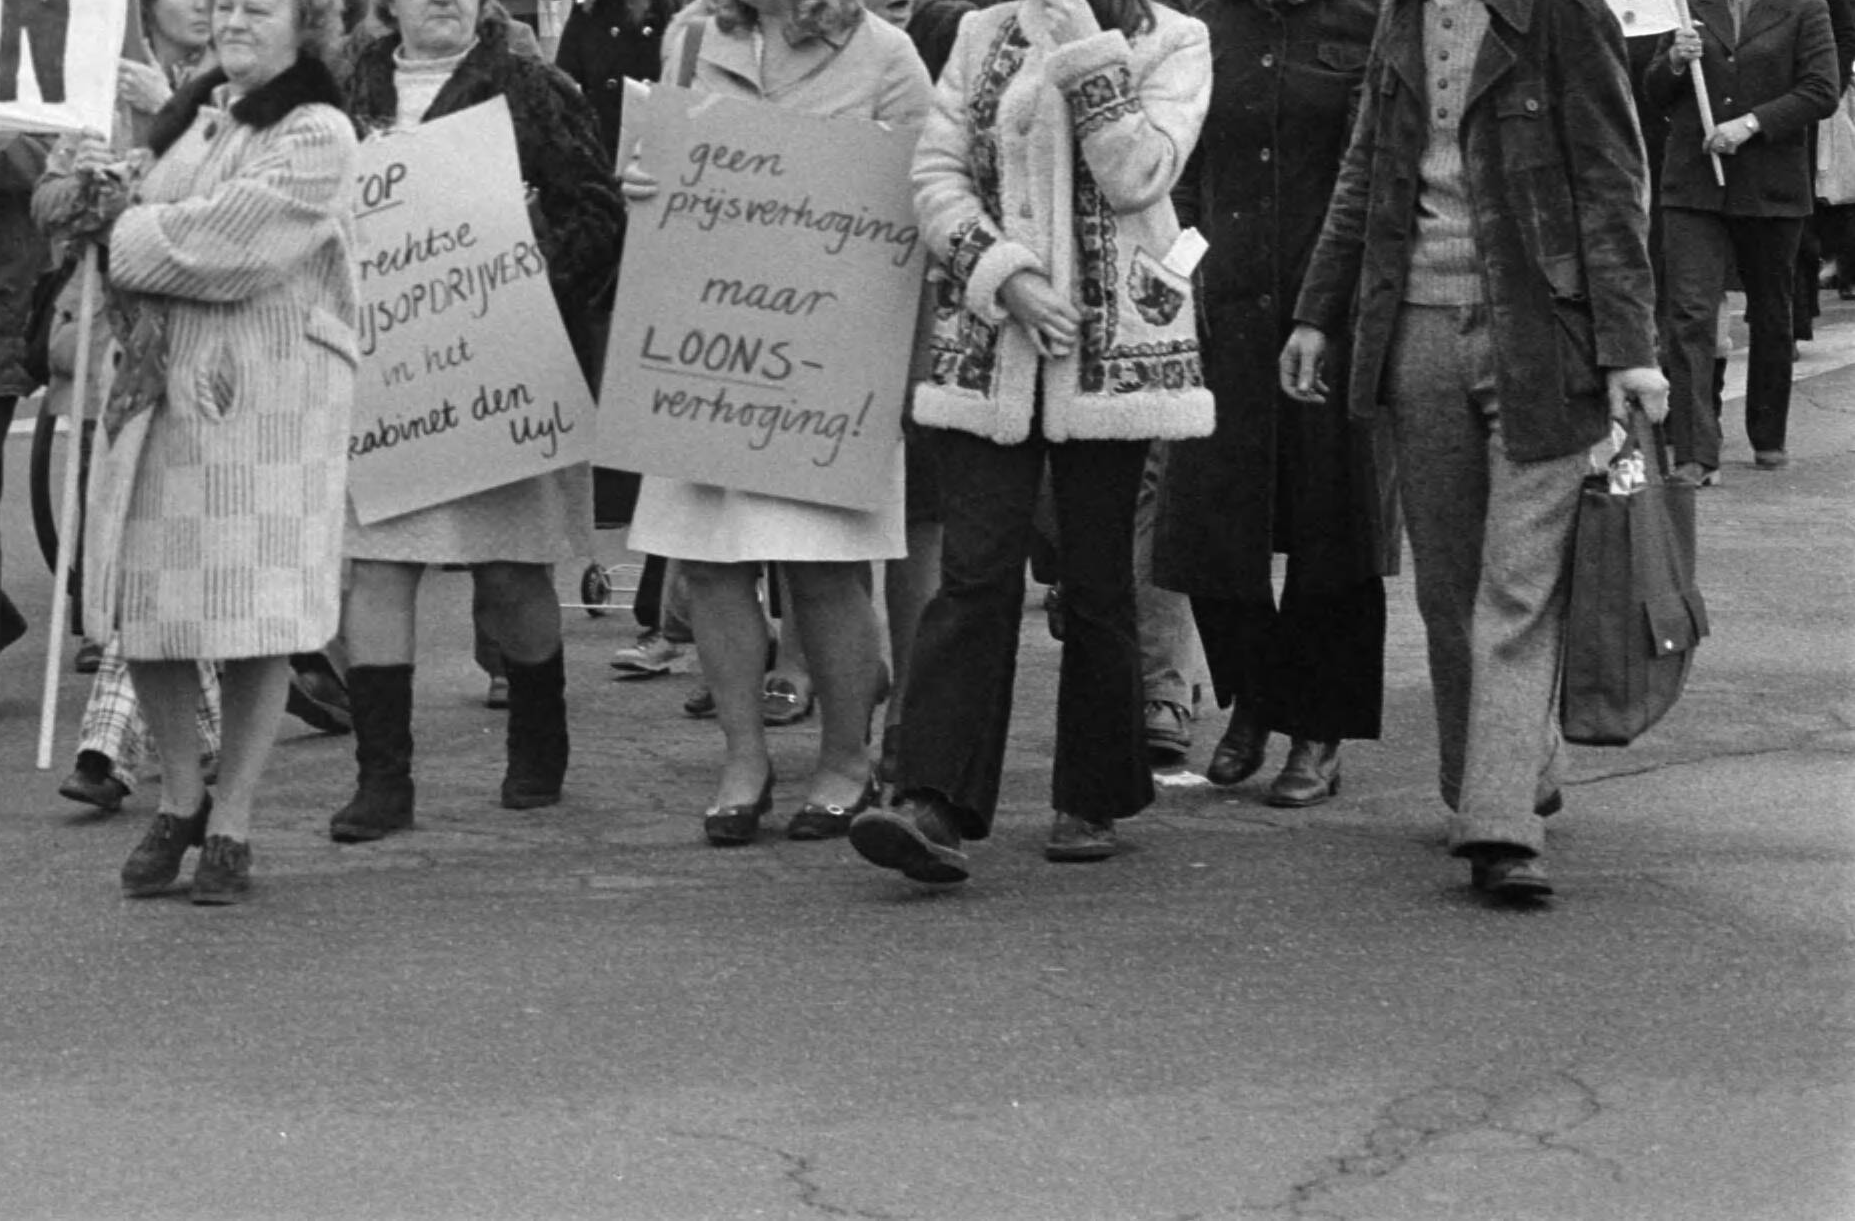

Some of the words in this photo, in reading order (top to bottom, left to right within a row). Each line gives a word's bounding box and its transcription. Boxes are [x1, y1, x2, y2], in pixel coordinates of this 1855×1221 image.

[357, 162, 407, 208] OP
[680, 143, 785, 188] geen
[359, 222, 478, 280] rechtse
[700, 278, 839, 316] maar
[640, 325, 824, 381] LOONS-
[471, 383, 535, 421] den
[650, 386, 875, 468] verhoging!
